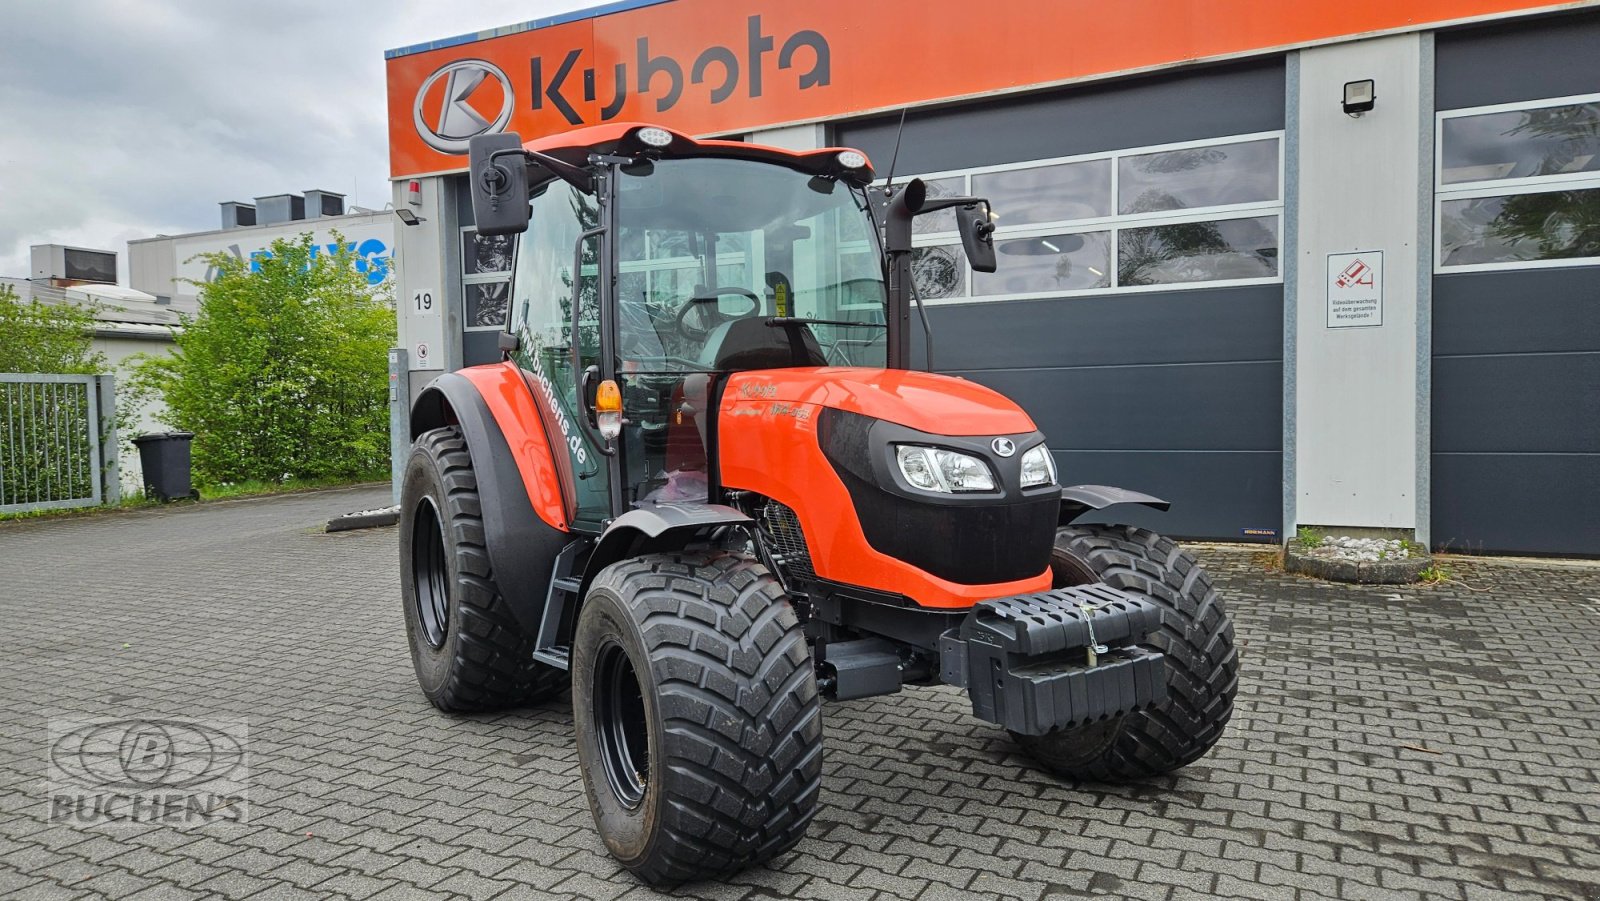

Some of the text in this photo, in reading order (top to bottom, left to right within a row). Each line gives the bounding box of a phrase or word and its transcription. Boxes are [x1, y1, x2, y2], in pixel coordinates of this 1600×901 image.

[530, 14, 831, 126] Kubota
[414, 293, 432, 311] 19
[516, 314, 587, 465] www.buchens.de
